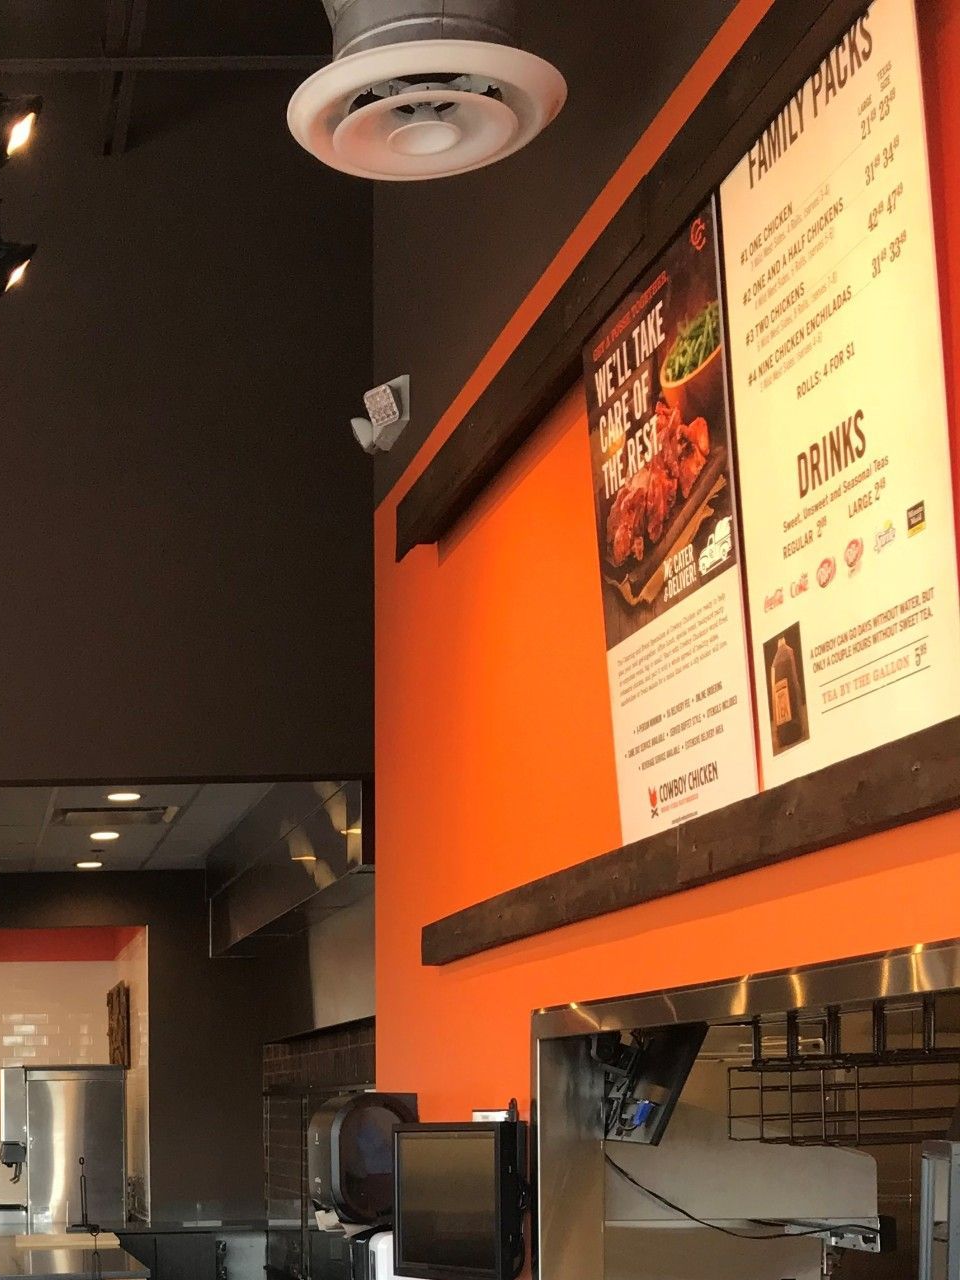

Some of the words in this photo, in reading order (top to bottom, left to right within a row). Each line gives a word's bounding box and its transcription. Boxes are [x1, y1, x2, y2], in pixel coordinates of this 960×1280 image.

[748, 86, 804, 190] FAMILY
[810, 9, 873, 119] PACKS
[749, 233, 762, 257] ONE
[763, 201, 793, 242] CHICKEN
[752, 274, 766, 297] ONE
[767, 260, 781, 286] AND
[788, 234, 806, 263] HALF
[807, 197, 844, 244] CHICKENS
[755, 315, 770, 338] TWO
[770, 282, 806, 324] CHICKENS
[758, 354, 774, 377] NINE
[775, 326, 805, 364] CHICKEN
[806, 285, 852, 337] ENCHILADAS
[594, 341, 632, 408] WE'LL
[632, 300, 666, 368] TAKE
[797, 371, 822, 400] ROLLS:
[830, 351, 845, 374] FOR
[599, 391, 631, 454] CARE
[632, 369, 649, 420] OF
[602, 446, 626, 499] THE
[627, 414, 663, 478] REST.
[797, 409, 866, 499] DRINKS
[803, 495, 829, 520] Unsweet
[830, 484, 842, 503] and
[843, 464, 872, 494] Seasonal
[873, 456, 889, 473] Teas
[848, 491, 874, 519] LARGE
[673, 543, 695, 575] CATER
[783, 530, 814, 560] REGULAR
[667, 566, 697, 600] DELIVER!
[814, 639, 836, 658] COWBOY
[837, 633, 849, 648] CAN
[872, 606, 899, 627] WITHOUT
[922, 587, 934, 604] BUT
[831, 646, 852, 664] COUPLE
[853, 635, 872, 656] HOURS
[872, 622, 899, 644] WITHOUT
[899, 614, 919, 632] SWEET
[822, 690, 838, 705] TEA
[840, 681, 851, 696] BY
[853, 673, 871, 691] THE
[873, 656, 910, 682] GALLON
[658, 773, 688, 803] COWBOY
[688, 761, 719, 791] CHICKEN
